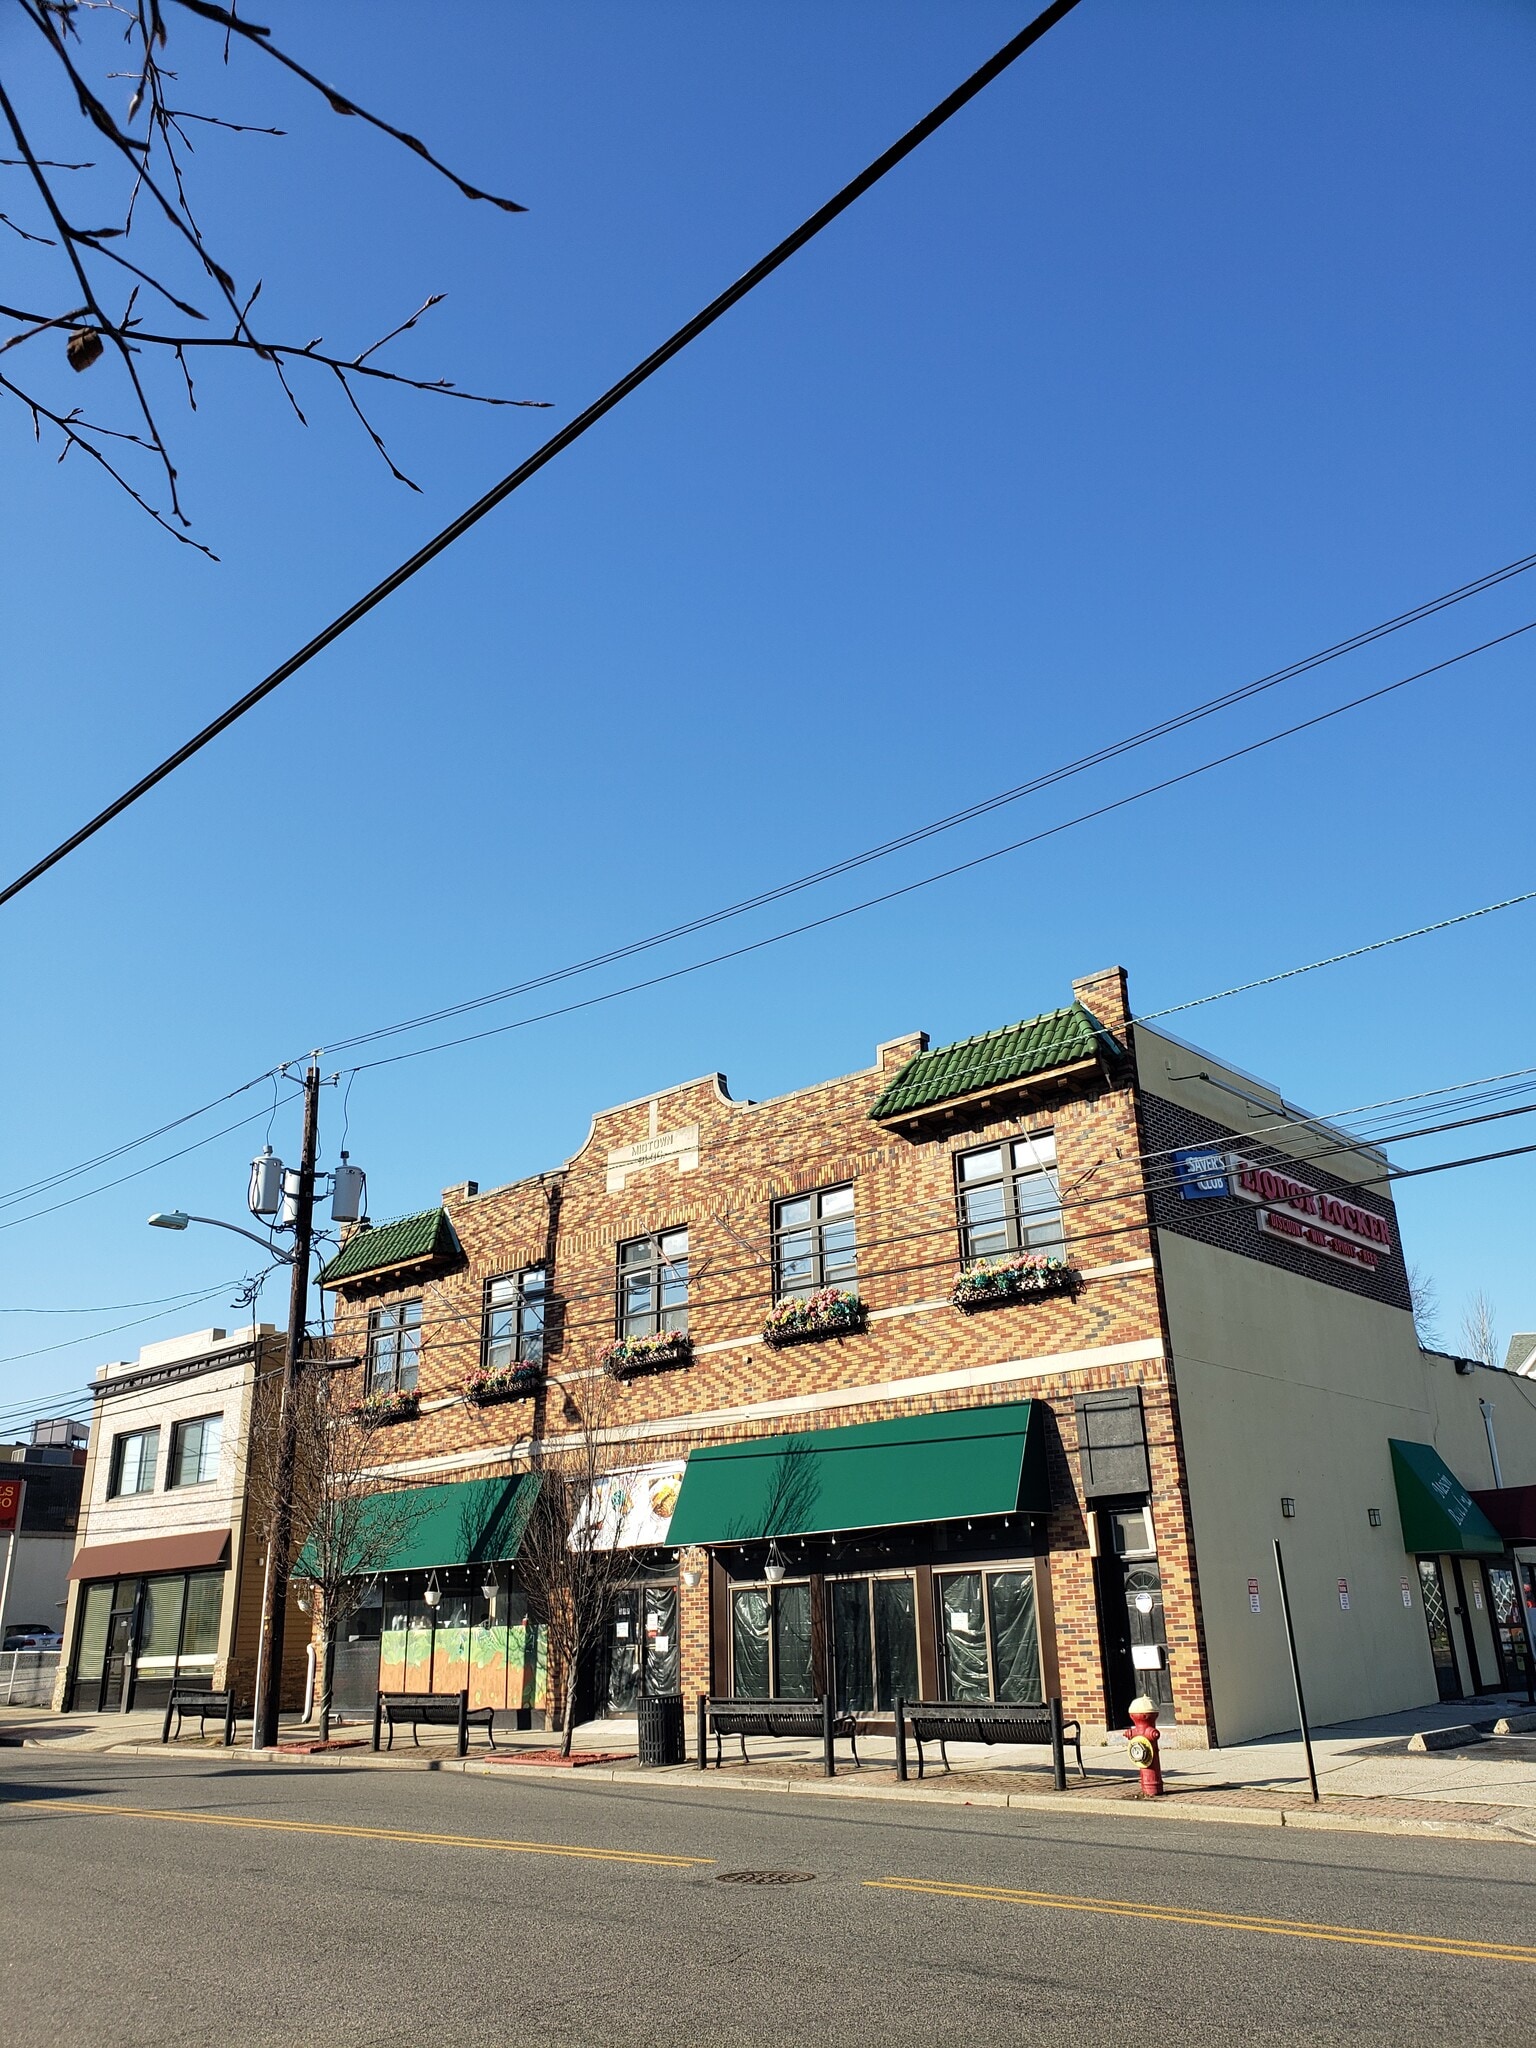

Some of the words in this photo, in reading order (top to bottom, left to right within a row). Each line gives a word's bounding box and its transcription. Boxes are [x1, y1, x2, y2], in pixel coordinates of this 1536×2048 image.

[631, 1134, 674, 1157] MIDTOWN
[1196, 1174, 1225, 1191] CLUB
[1237, 1161, 1318, 1216] LIQUOR
[1318, 1195, 1393, 1246] LOCKER
